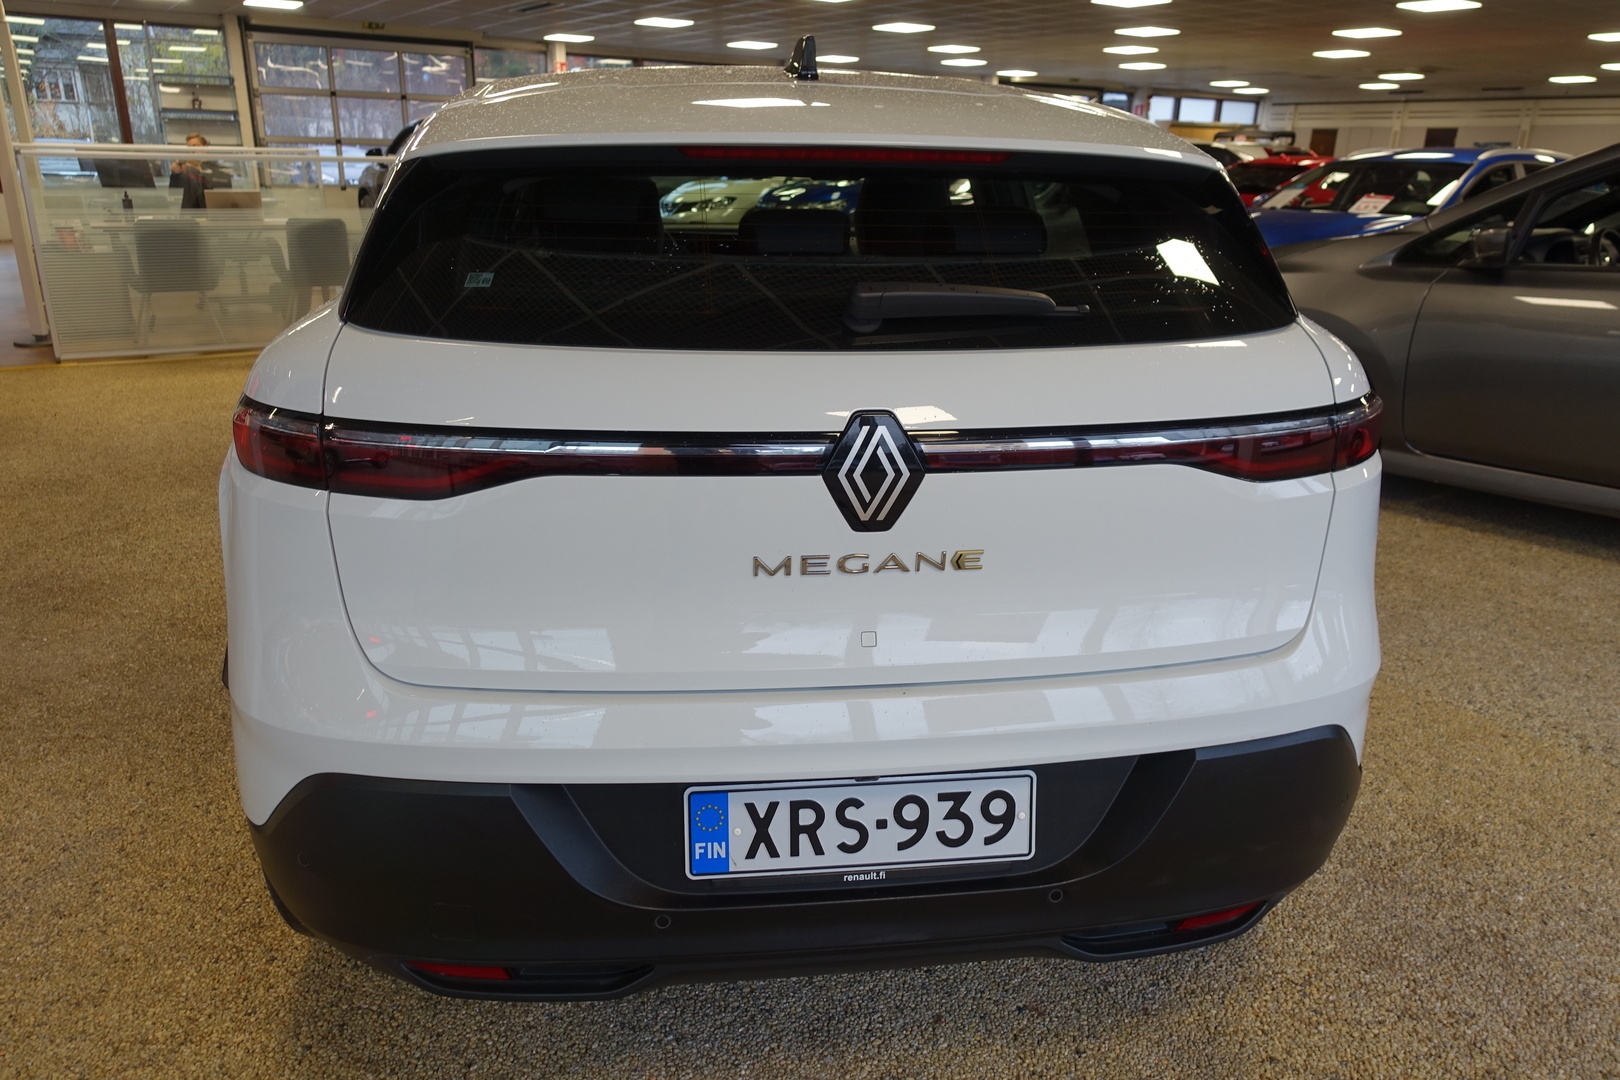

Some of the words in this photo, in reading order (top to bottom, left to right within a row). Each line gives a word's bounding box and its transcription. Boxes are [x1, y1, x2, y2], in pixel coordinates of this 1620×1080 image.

[753, 549, 984, 577] MEGANE
[744, 789, 1017, 860] XRS-939
[694, 841, 727, 860] FIN
[843, 870, 886, 882] renault.fi
